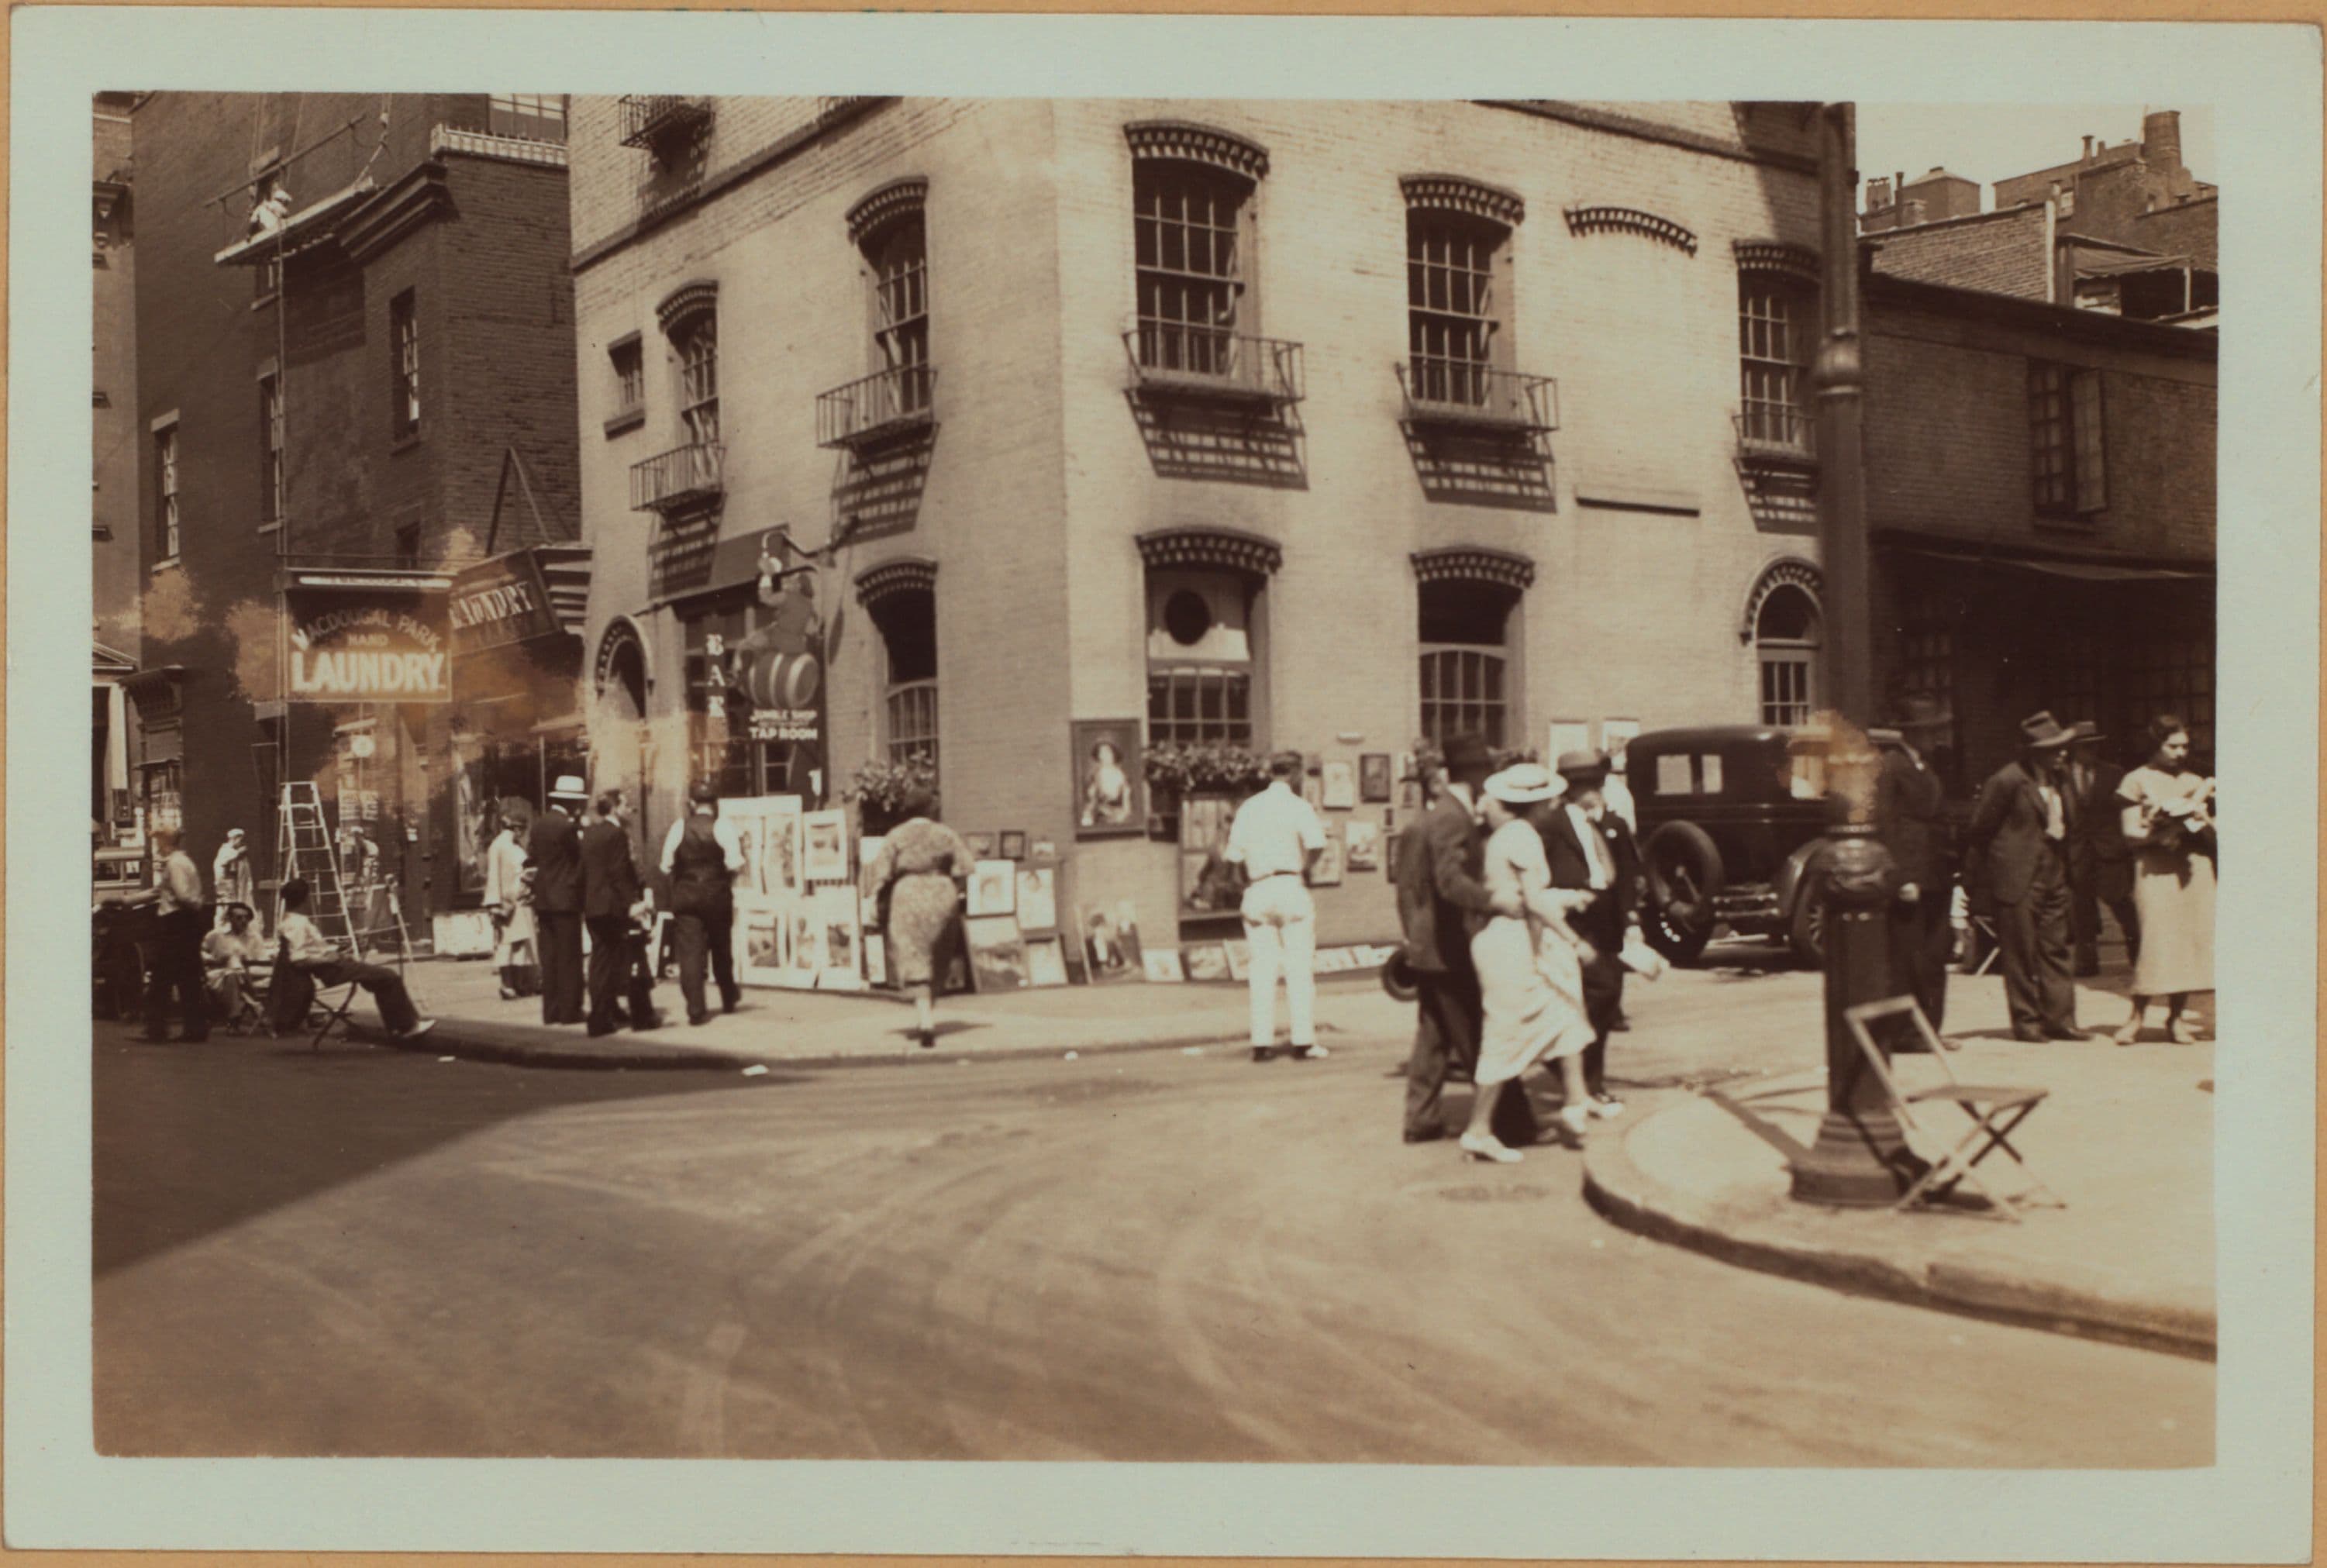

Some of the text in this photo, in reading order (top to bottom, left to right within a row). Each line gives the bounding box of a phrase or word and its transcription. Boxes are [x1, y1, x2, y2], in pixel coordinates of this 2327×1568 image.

[348, 633, 388, 646] HAND
[397, 614, 440, 653] PARK
[291, 651, 445, 692] LAUNDRY
[748, 727, 818, 740] TAP ROOM
